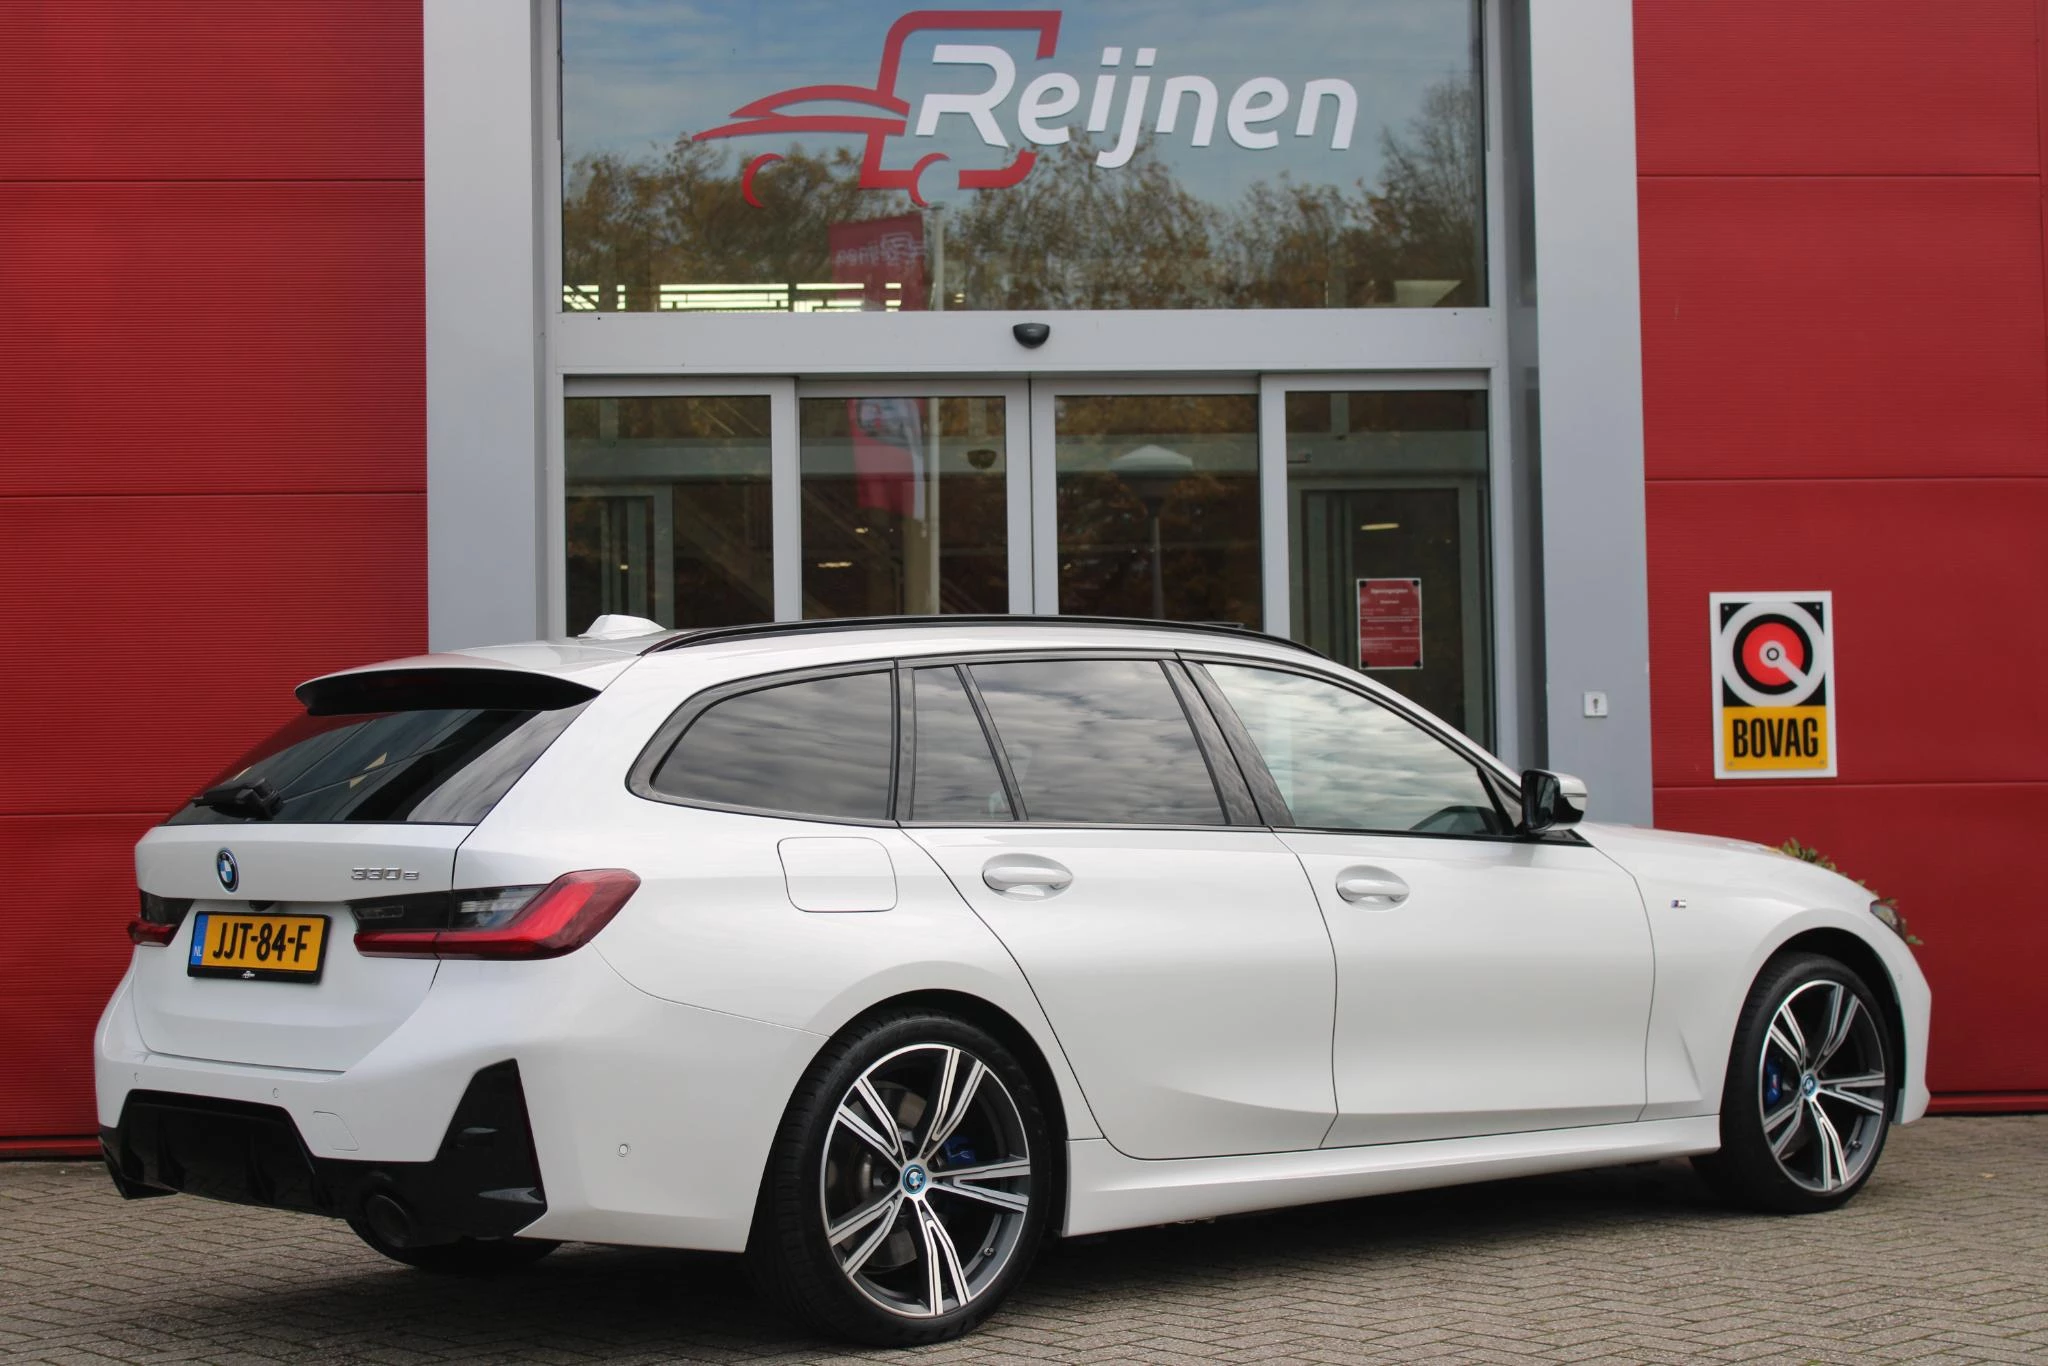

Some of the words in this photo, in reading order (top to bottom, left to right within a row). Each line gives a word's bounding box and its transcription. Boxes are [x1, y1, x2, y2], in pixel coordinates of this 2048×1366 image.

[915, 44, 1358, 169] Reijnen
[1732, 717, 1819, 758] BOVAG
[212, 922, 312, 962] JJT-84-F
